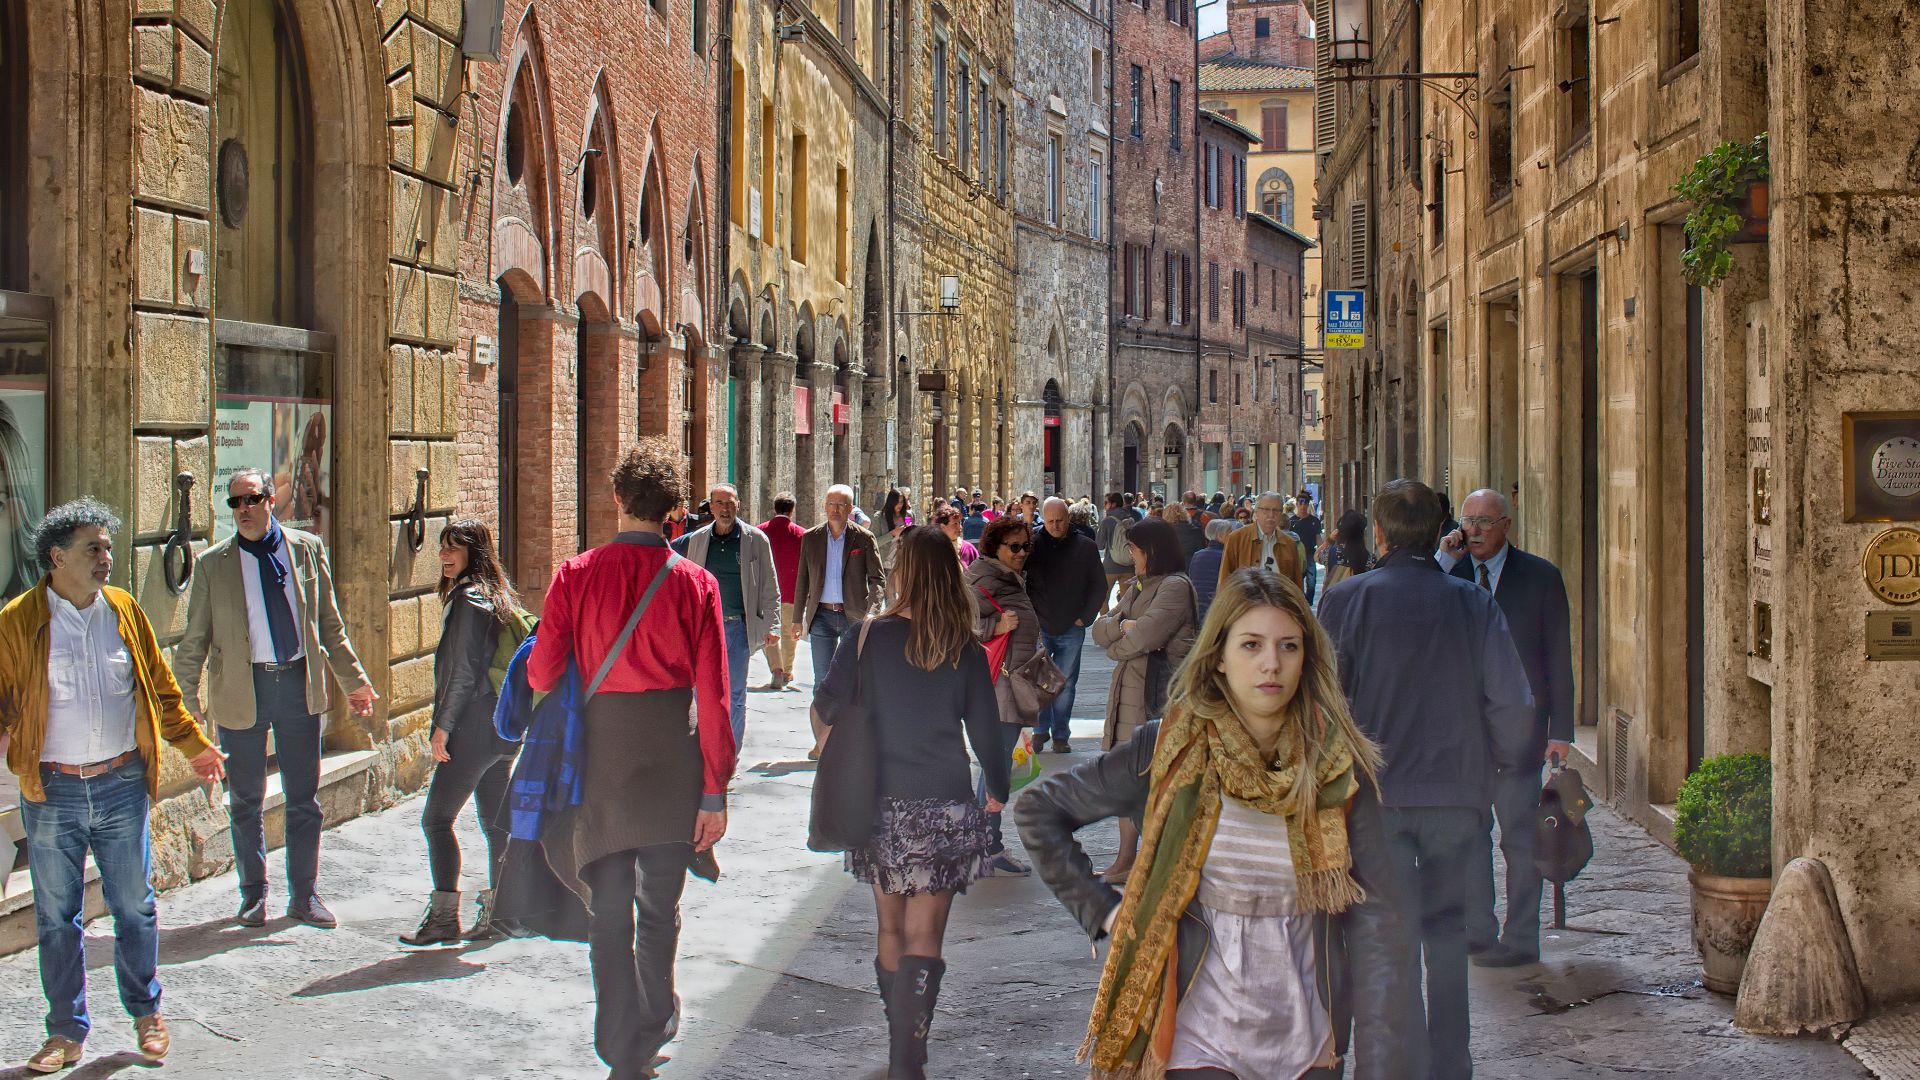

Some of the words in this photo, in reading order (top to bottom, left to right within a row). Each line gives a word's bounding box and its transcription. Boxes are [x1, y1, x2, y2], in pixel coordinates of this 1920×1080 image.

[1336, 295, 1355, 320] T
[1748, 407, 1762, 423] GRAND
[215, 420, 230, 430] Conto
[231, 420, 250, 431] Italiano
[215, 436, 220, 447] di
[221, 436, 244, 448] Deposito
[1876, 458, 1903, 469] Five
[219, 466, 233, 478] posto
[214, 484, 223, 494] per
